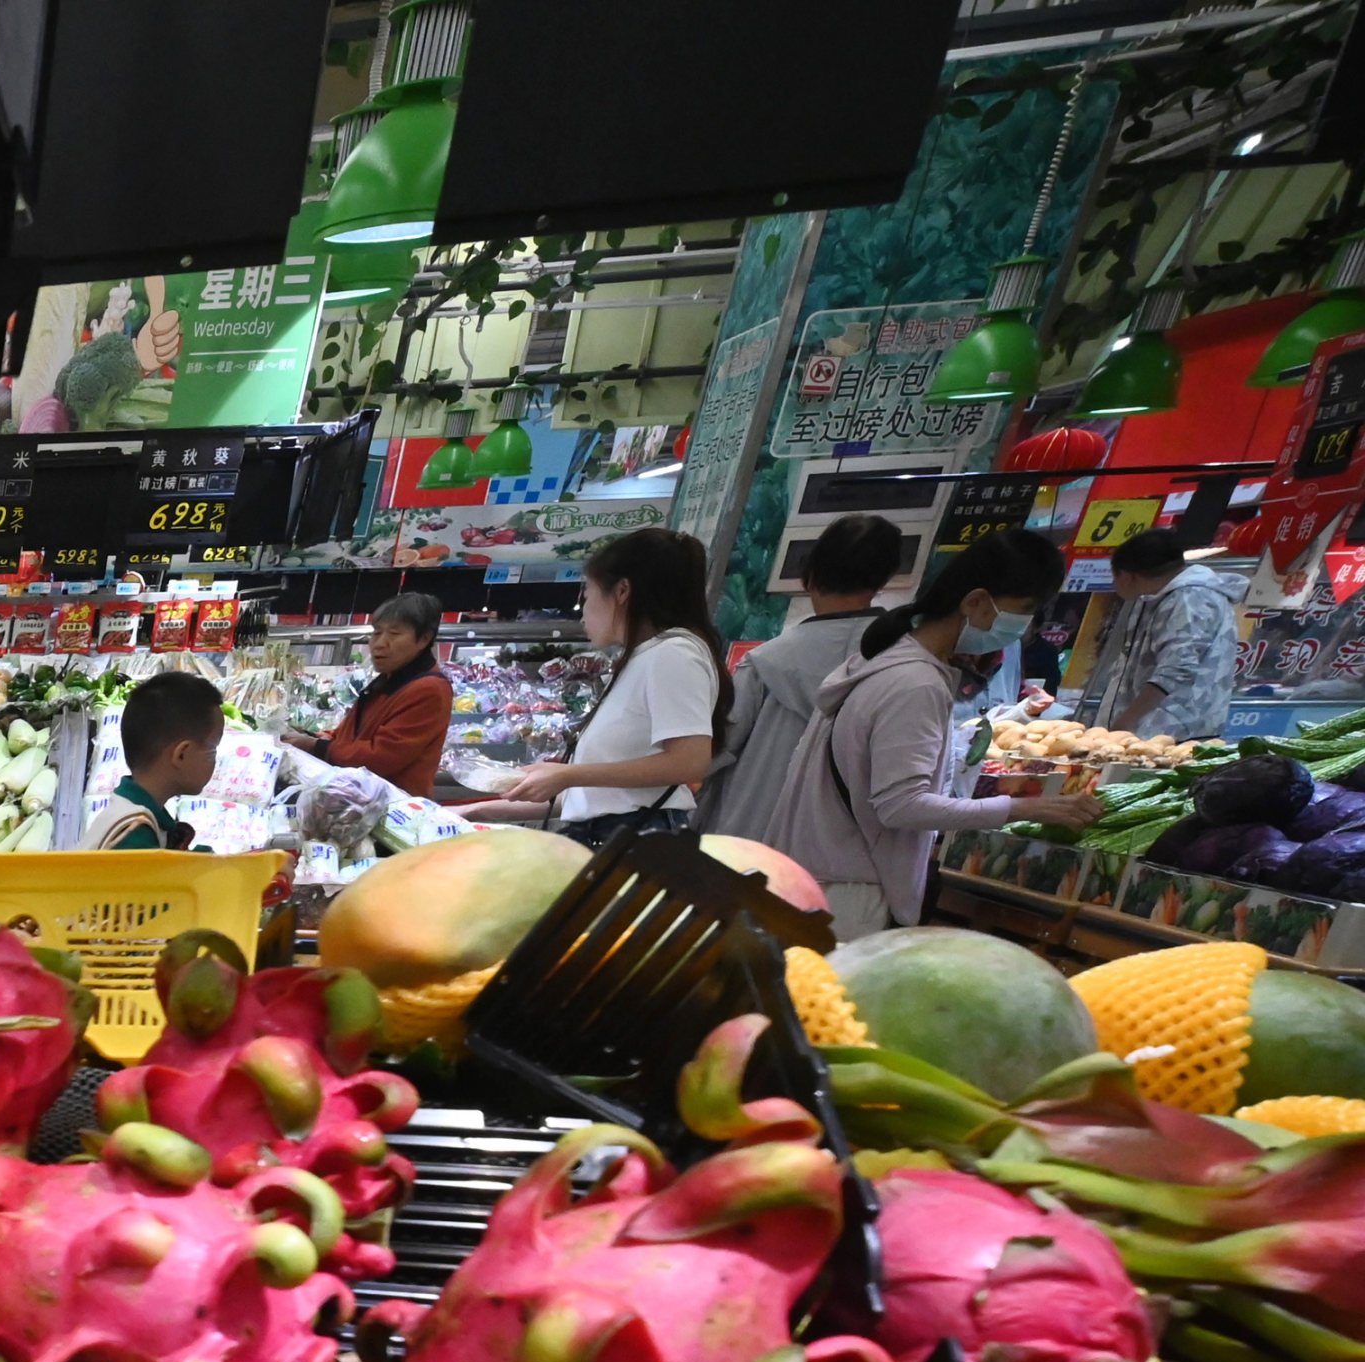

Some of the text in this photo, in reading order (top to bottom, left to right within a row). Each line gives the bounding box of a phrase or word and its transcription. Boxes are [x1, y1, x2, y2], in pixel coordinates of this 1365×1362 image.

[198, 256, 315, 310] 星期三
[194, 317, 275, 338] Wednesday
[877, 317, 991, 345] 自助式包
[786, 402, 986, 444] 至过磅处过磅
[151, 447, 230, 468] 黄秋葵
[139, 476, 177, 491] 请过磅
[1090, 511, 1122, 543] 5
